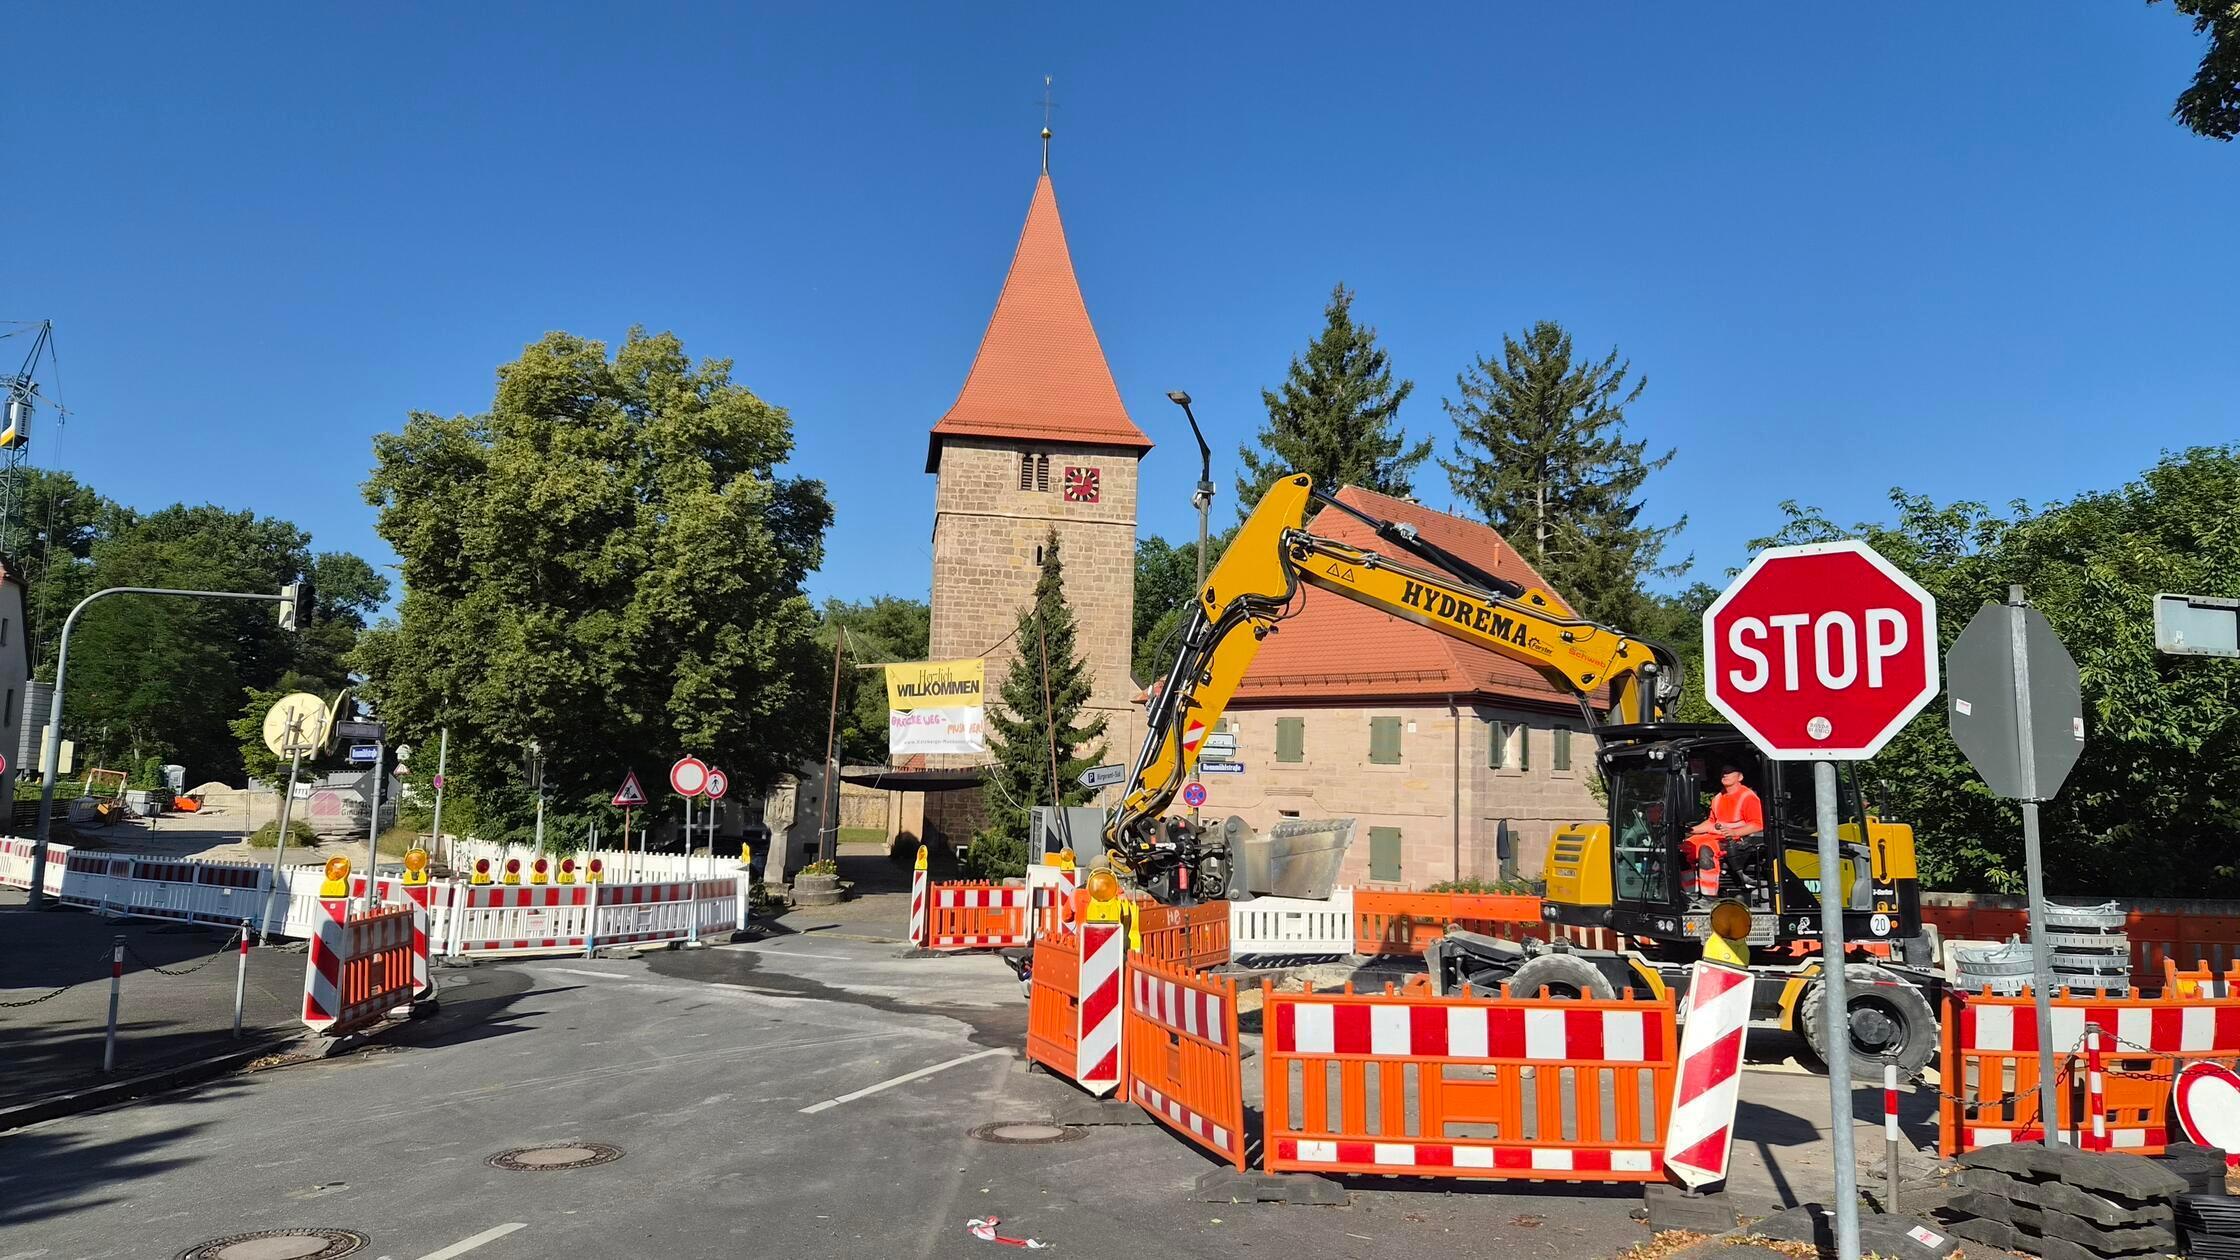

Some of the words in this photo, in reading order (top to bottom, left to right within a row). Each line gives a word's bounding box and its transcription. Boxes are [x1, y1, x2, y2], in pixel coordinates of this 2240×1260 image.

[1401, 580, 1528, 648] HYDREMA
[1568, 647, 1606, 669] Schwab
[1728, 607, 1908, 693] STOP
[919, 667, 953, 684] Herzlich
[897, 680, 980, 697] WILLKOMMEN
[1874, 918, 1886, 931] 20
